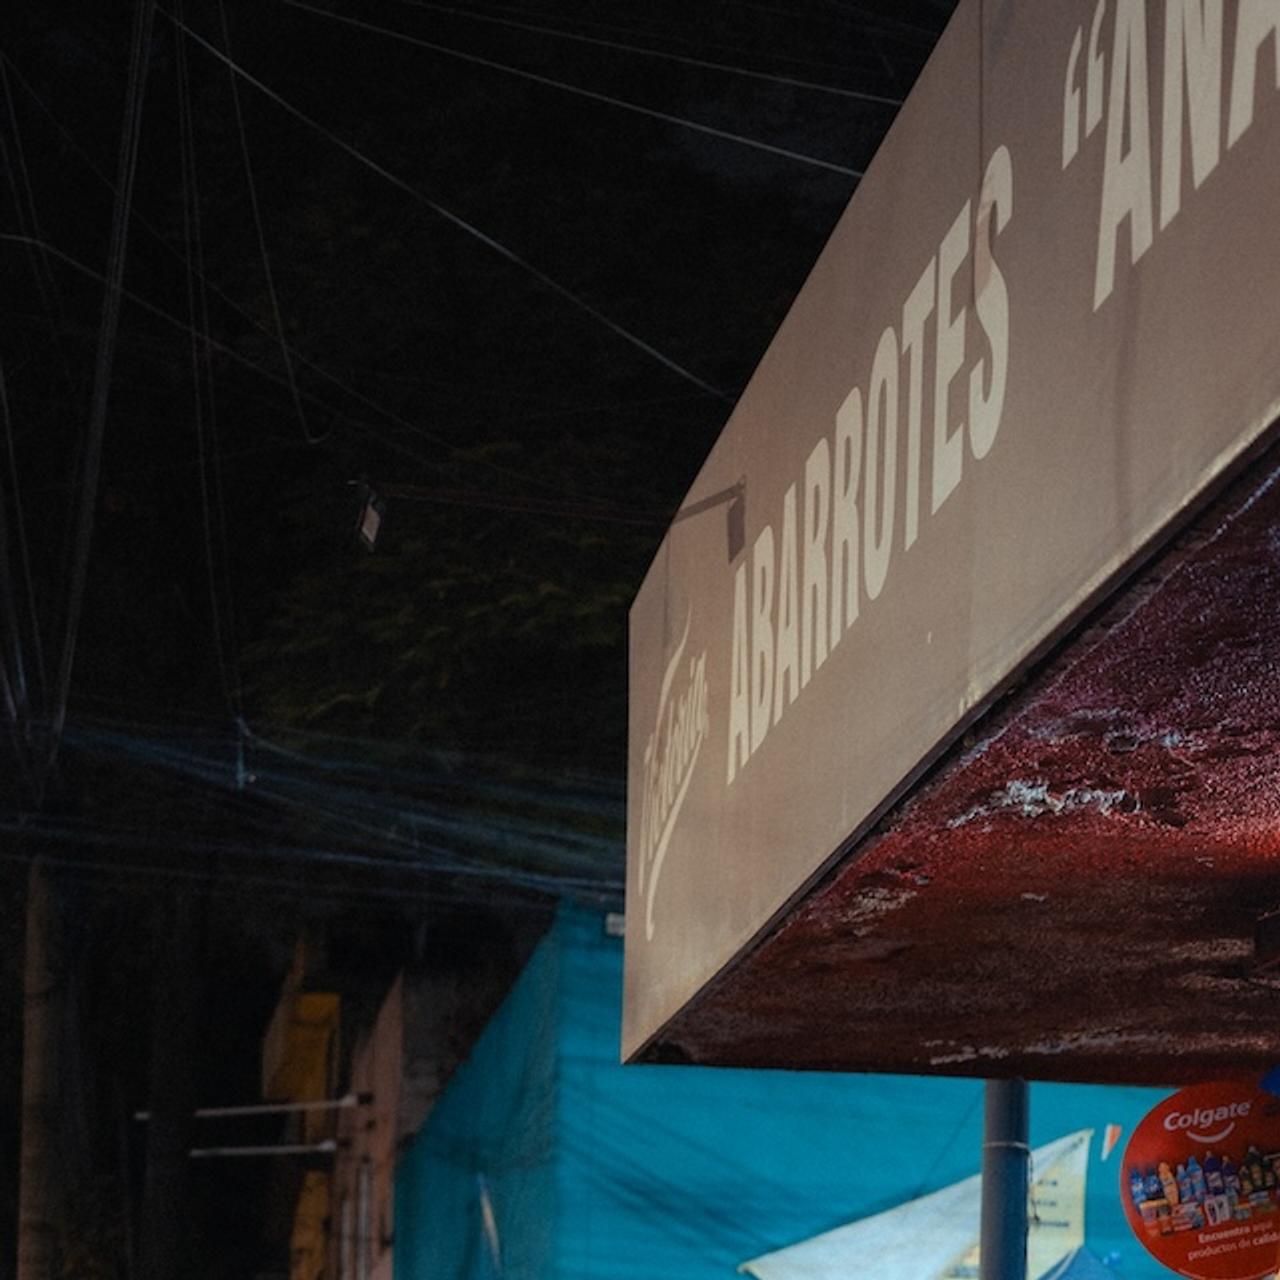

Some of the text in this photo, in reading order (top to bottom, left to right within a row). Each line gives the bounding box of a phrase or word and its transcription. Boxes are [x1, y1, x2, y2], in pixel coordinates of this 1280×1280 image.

[727, 145, 1013, 786] ABARROTES
[1163, 1101, 1250, 1131] Colgate
[1198, 1225, 1251, 1244] Encuentra
[1187, 1241, 1238, 1261] productos
